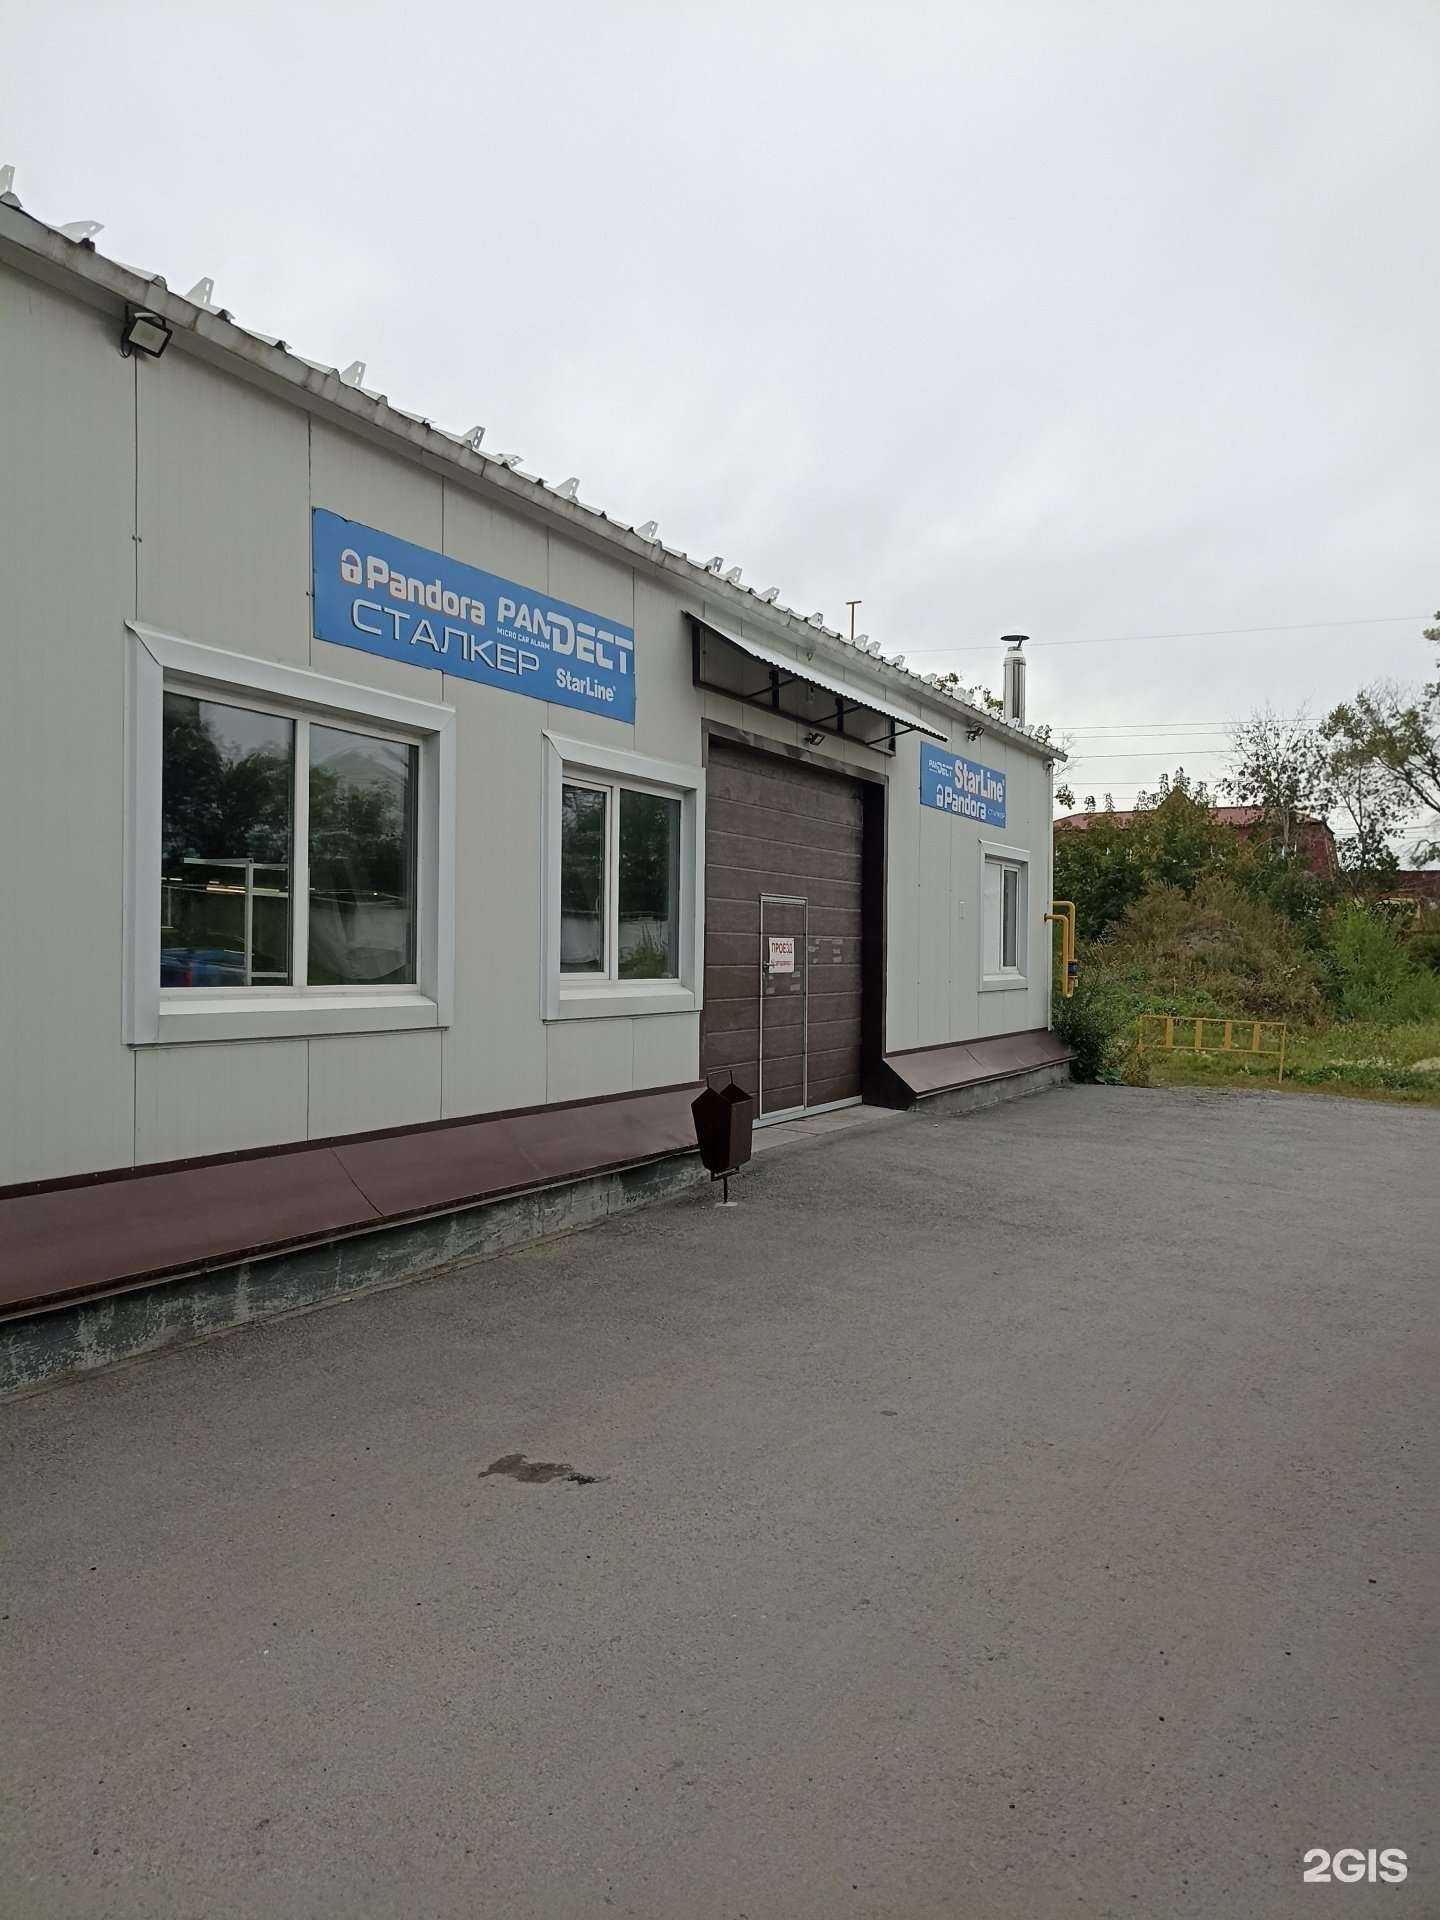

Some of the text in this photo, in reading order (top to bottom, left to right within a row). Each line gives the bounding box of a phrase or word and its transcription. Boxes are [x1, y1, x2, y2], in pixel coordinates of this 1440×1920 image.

[366, 555, 486, 626] Pandora
[352, 598, 540, 676] СТАЛКЕР
[496, 627, 551, 651] MICRO CAR ALARM
[497, 596, 634, 675] PANDECT
[556, 668, 614, 702] StarLine
[944, 786, 987, 820] Pandora
[954, 759, 1004, 803] StarLine
